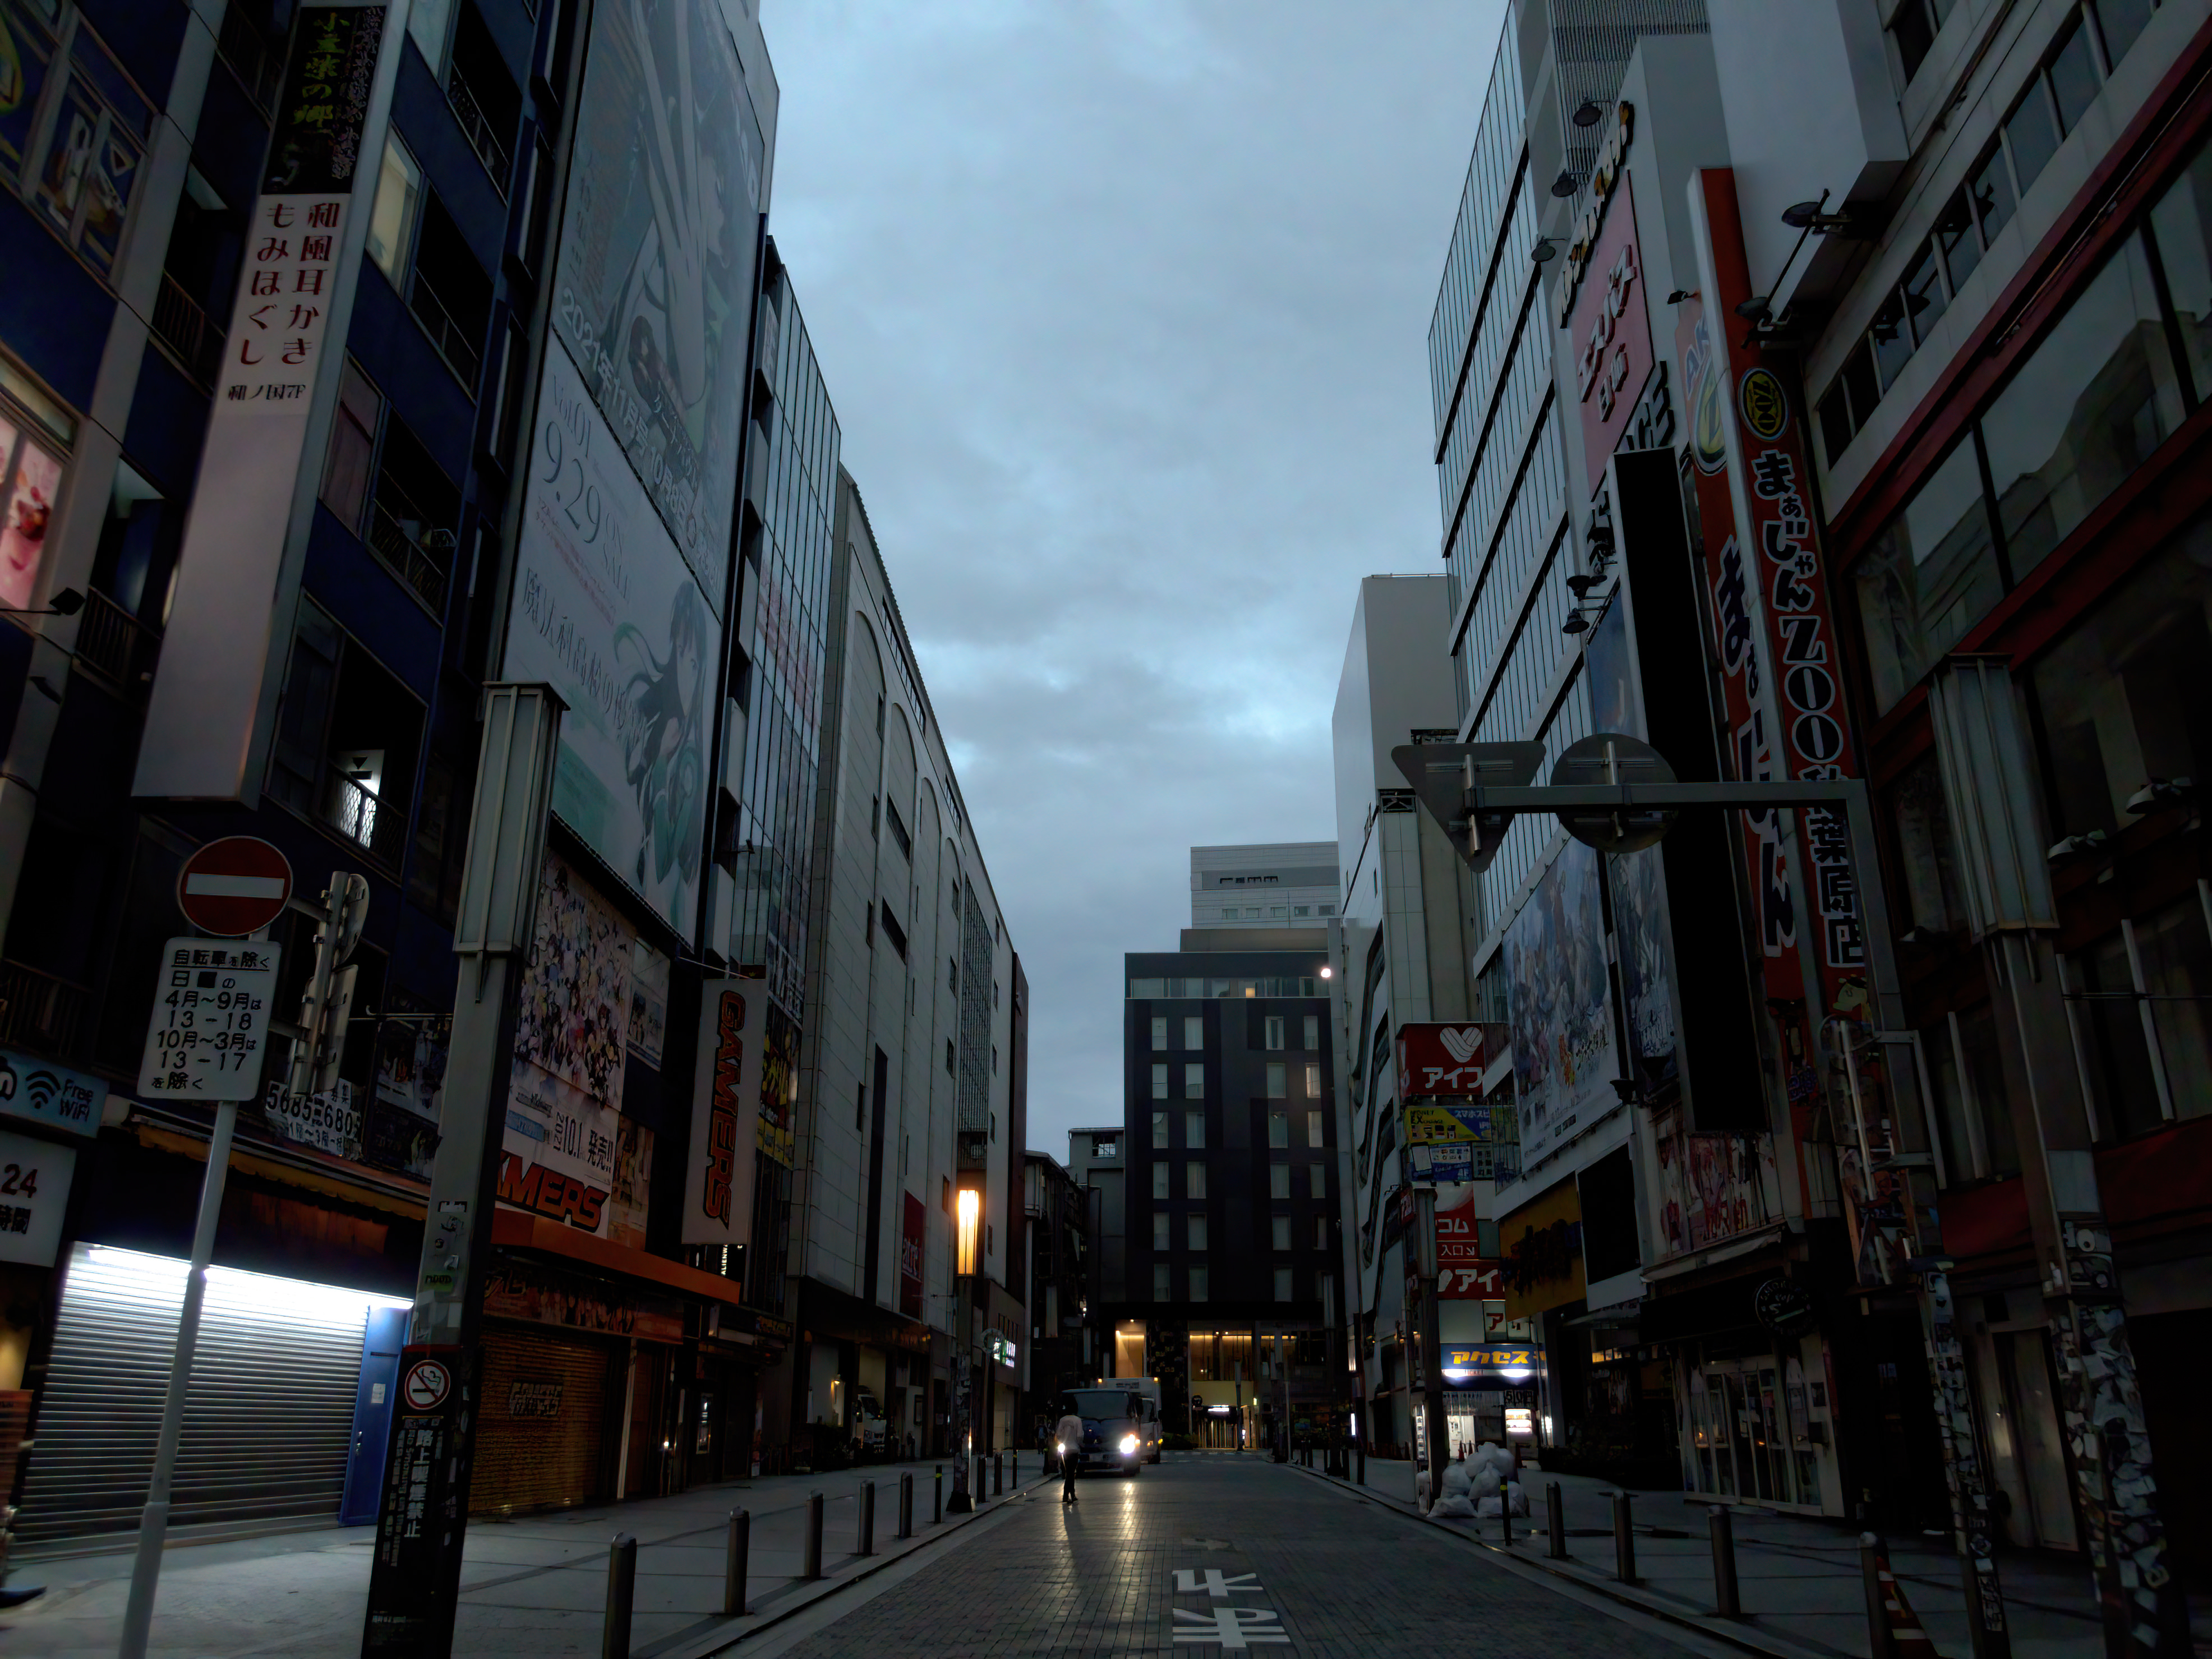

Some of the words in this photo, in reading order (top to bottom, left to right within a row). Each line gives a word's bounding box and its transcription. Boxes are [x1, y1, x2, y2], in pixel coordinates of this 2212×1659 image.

[241, 204, 294, 365] もみほぐし
[282, 203, 340, 365] 和風耳かき
[543, 421, 601, 544] 9.29
[171, 970, 236, 989] 日の
[702, 990, 746, 1229] GAMERS
[1435, 1218, 1469, 1234] コム
[1455, 1269, 1505, 1293] アイ
